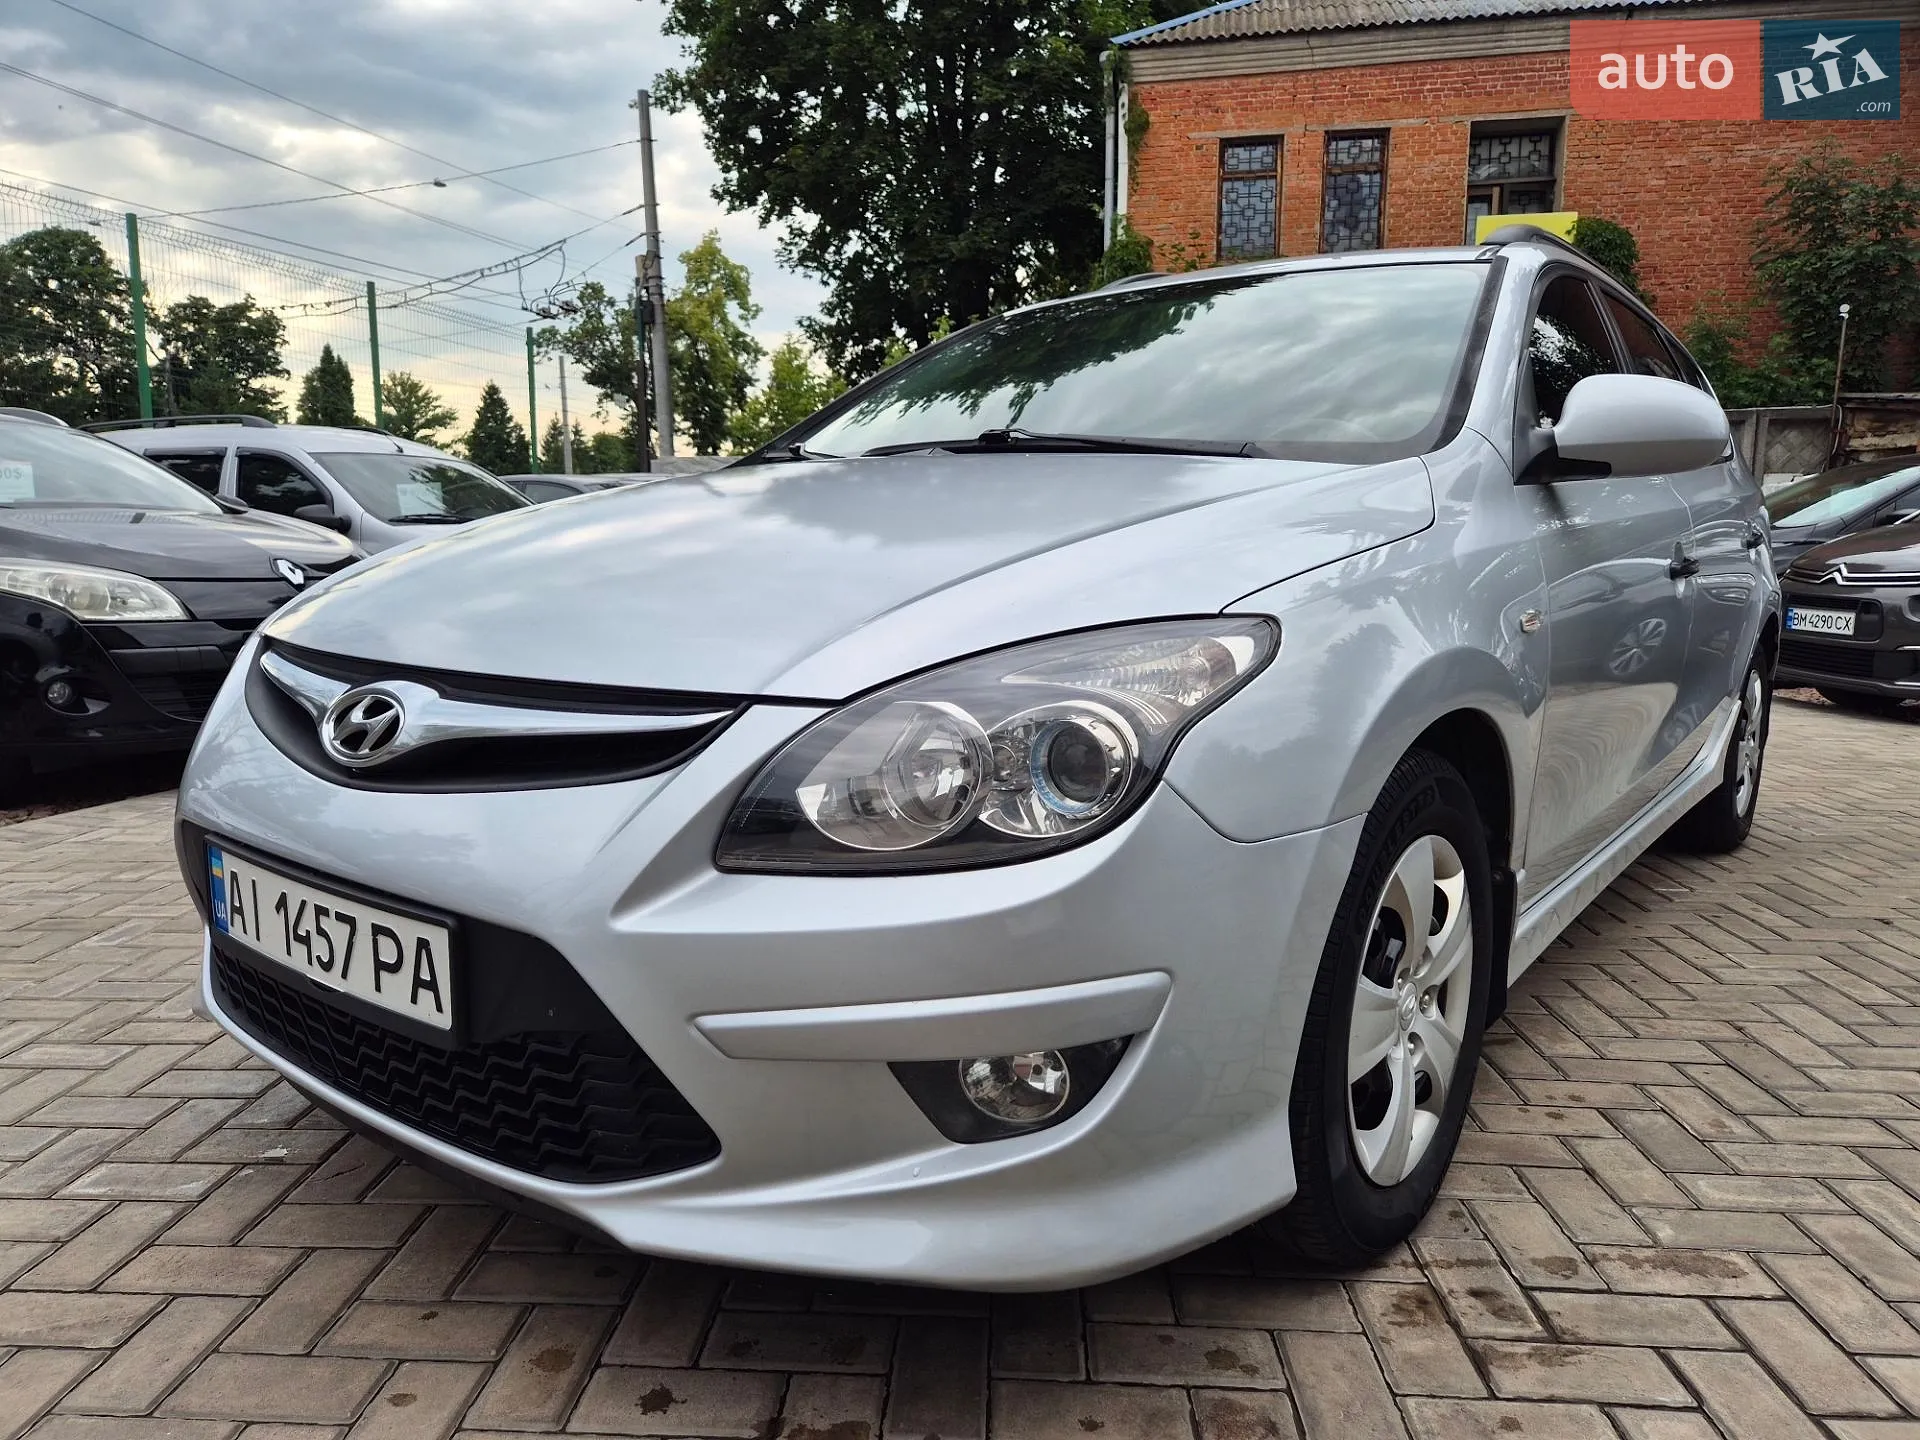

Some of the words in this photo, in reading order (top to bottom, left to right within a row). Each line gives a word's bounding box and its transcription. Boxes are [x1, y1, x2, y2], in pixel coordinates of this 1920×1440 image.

[1792, 612, 1807, 627] BM
[1808, 614, 1833, 629] 4290
[1834, 616, 1852, 631] CX
[214, 899, 227, 919] UA
[229, 869, 261, 943] AI
[274, 890, 357, 980] 1457
[370, 921, 444, 1014] PA
